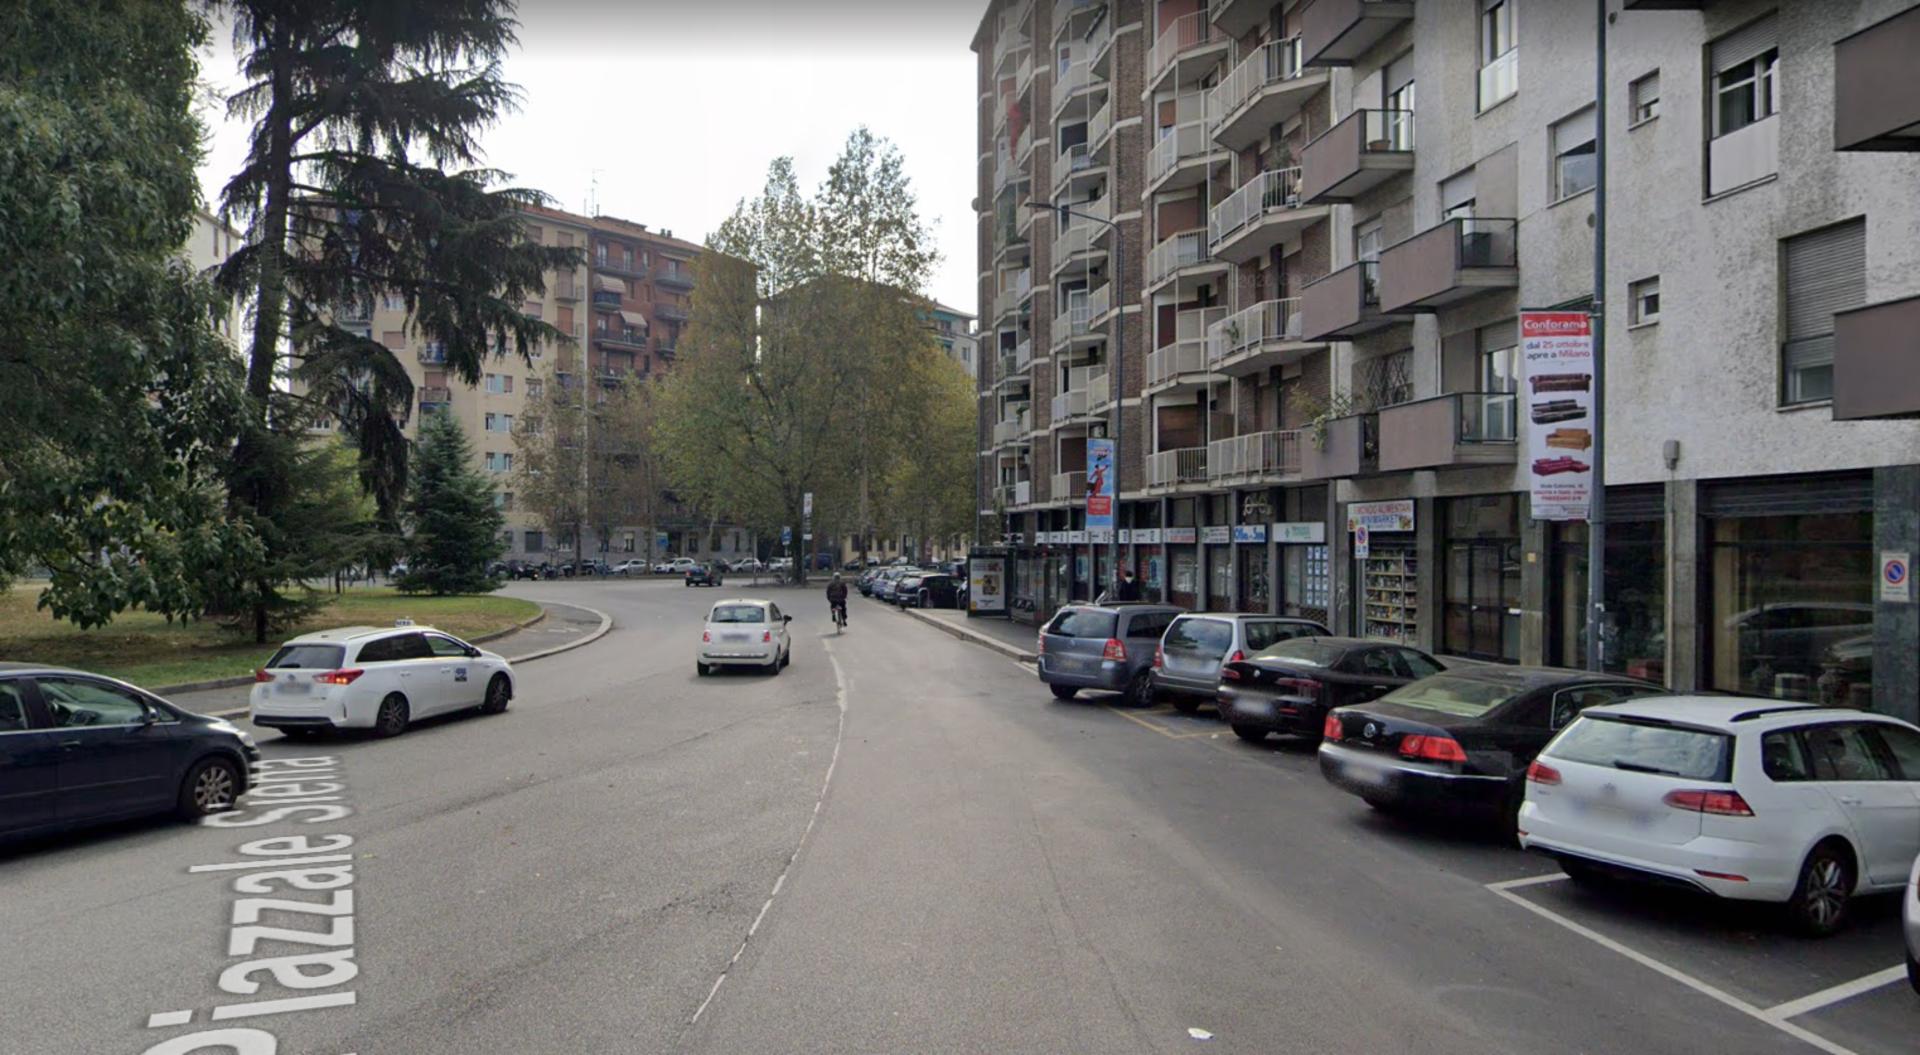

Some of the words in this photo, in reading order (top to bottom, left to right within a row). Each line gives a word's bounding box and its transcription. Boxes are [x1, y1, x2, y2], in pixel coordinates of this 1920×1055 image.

[1523, 319, 1588, 330] Conforama
[1526, 341, 1541, 350] dal
[1555, 340, 1589, 349] ottobre
[1527, 352, 1549, 360] apre
[1558, 349, 1591, 358] Milano
